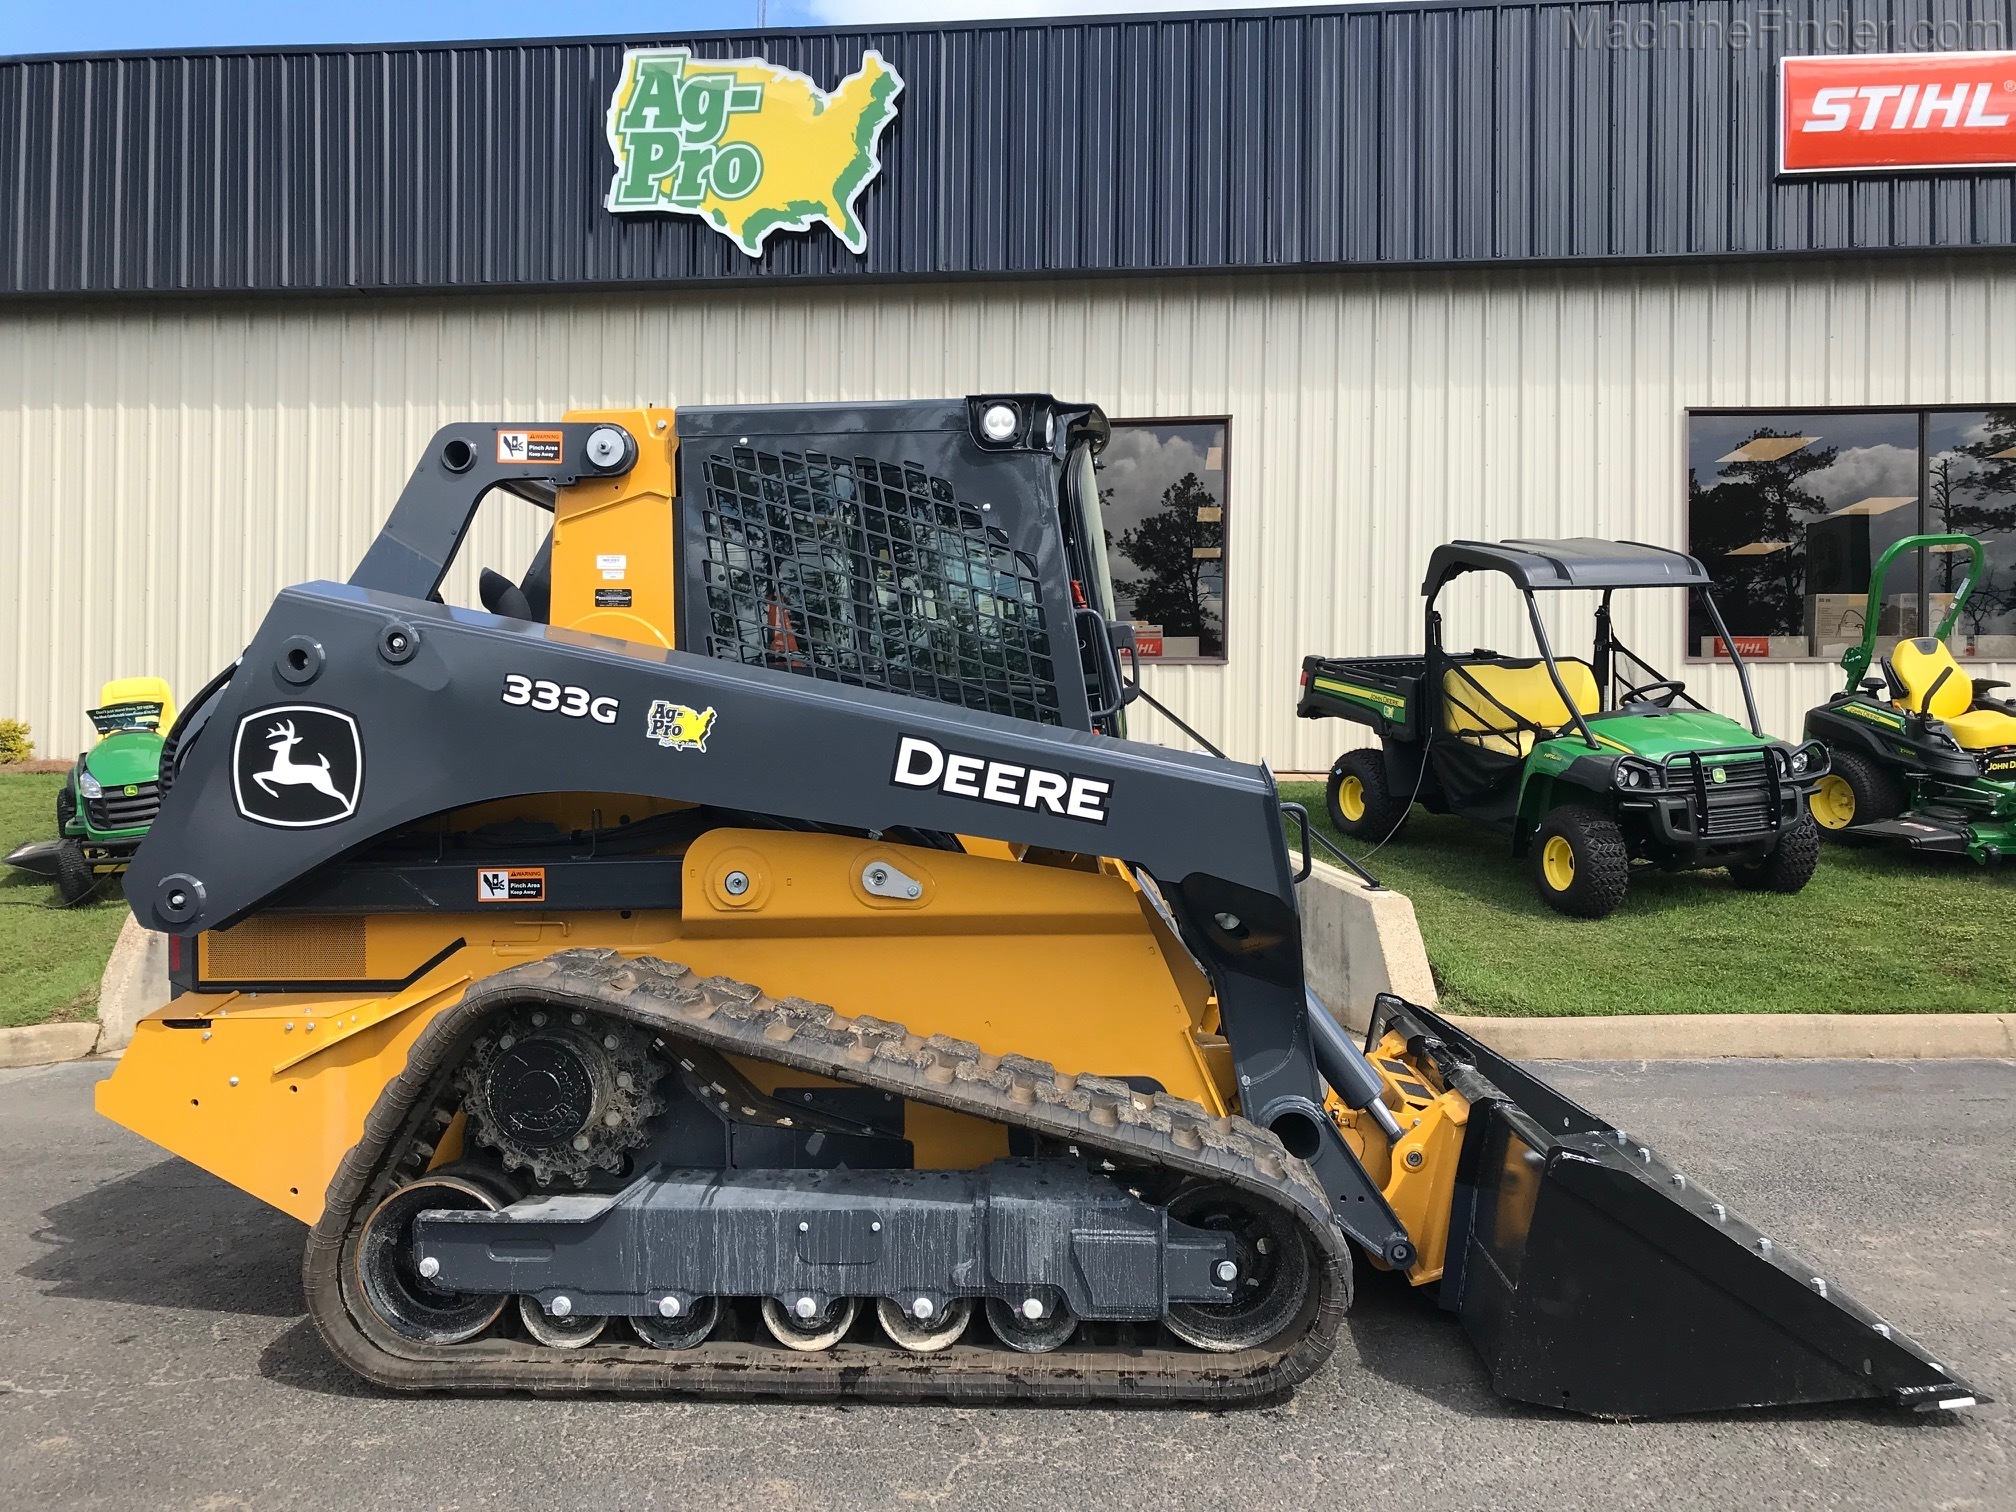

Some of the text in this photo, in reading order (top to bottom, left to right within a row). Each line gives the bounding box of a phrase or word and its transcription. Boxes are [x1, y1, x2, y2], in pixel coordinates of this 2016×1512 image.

[616, 54, 764, 147] Ag-
[1802, 83, 2010, 132] STIHL
[616, 131, 764, 205] Pro
[502, 674, 620, 725] 333G
[651, 703, 684, 723] Ag-
[651, 719, 683, 737] Pro
[893, 736, 1110, 822] DEERE
[1987, 762, 2009, 771] JOHN
